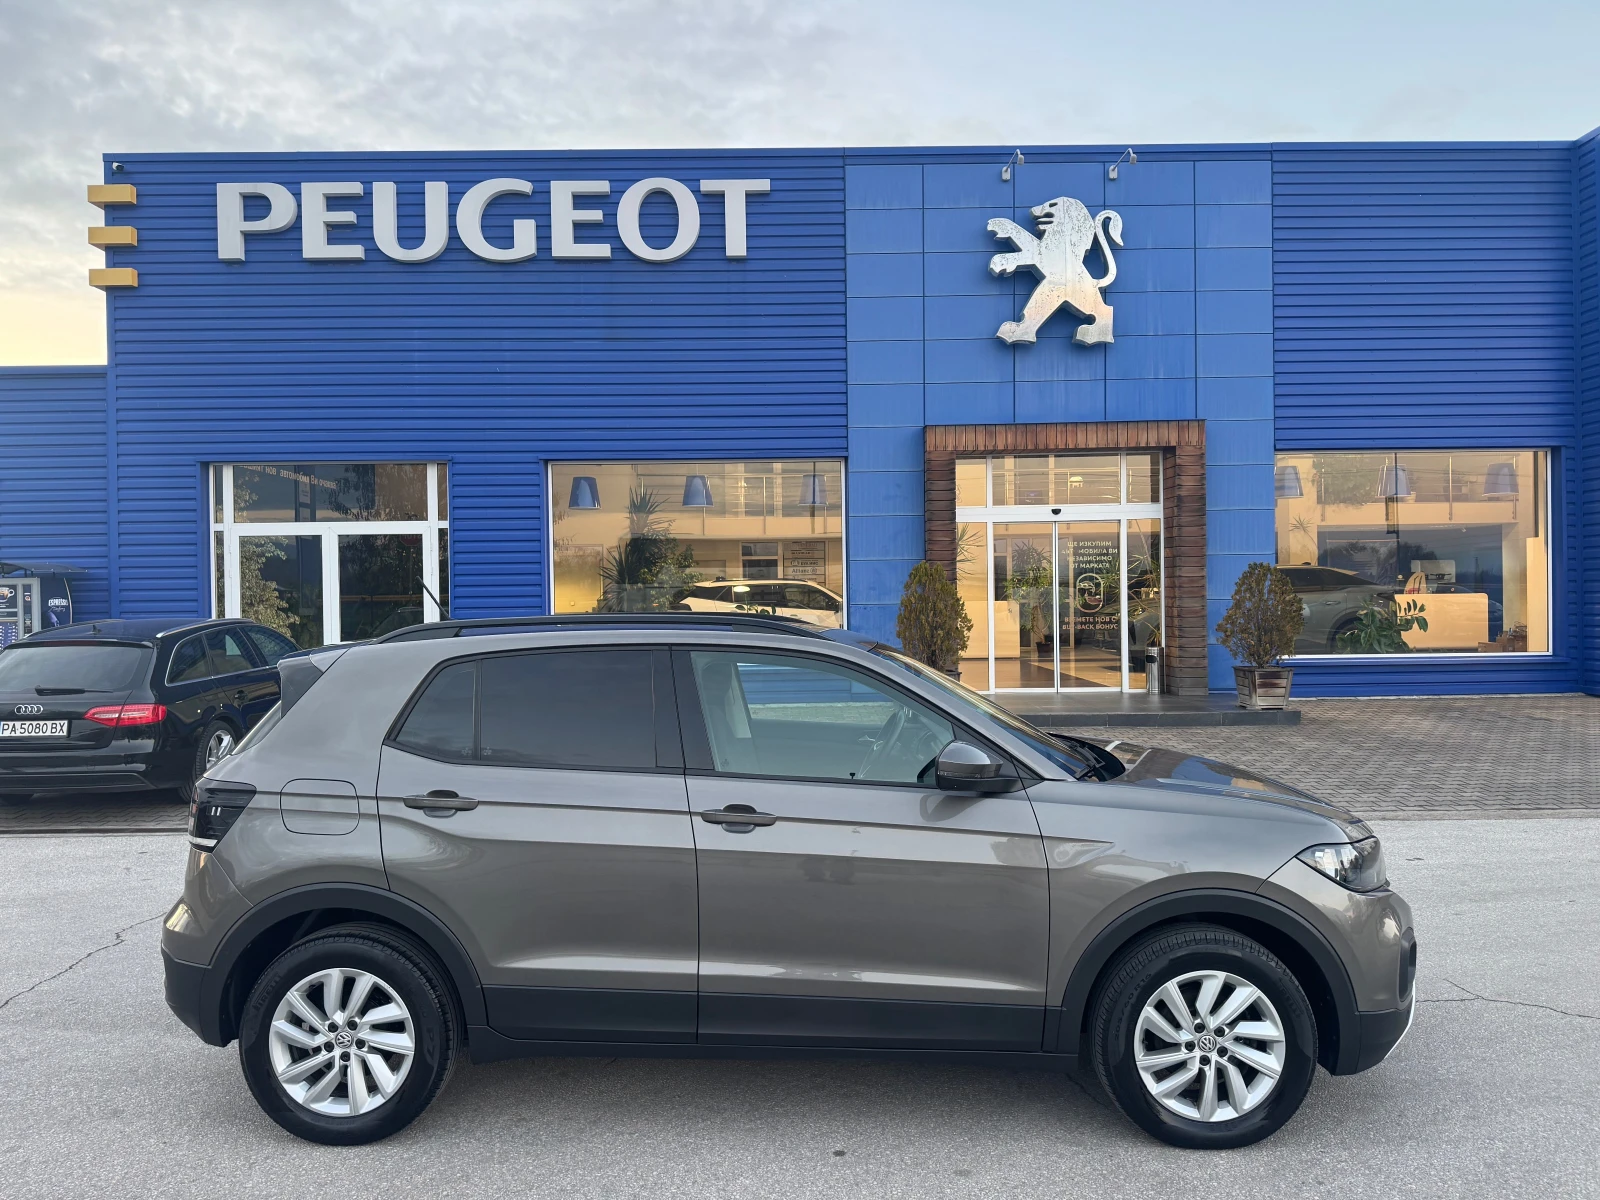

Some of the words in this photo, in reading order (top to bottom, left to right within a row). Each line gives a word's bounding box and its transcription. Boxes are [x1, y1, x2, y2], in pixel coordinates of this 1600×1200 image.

[217, 177, 771, 263] PEUGEOT
[19, 722, 48, 735] 5080
[50, 721, 66, 734] BX
